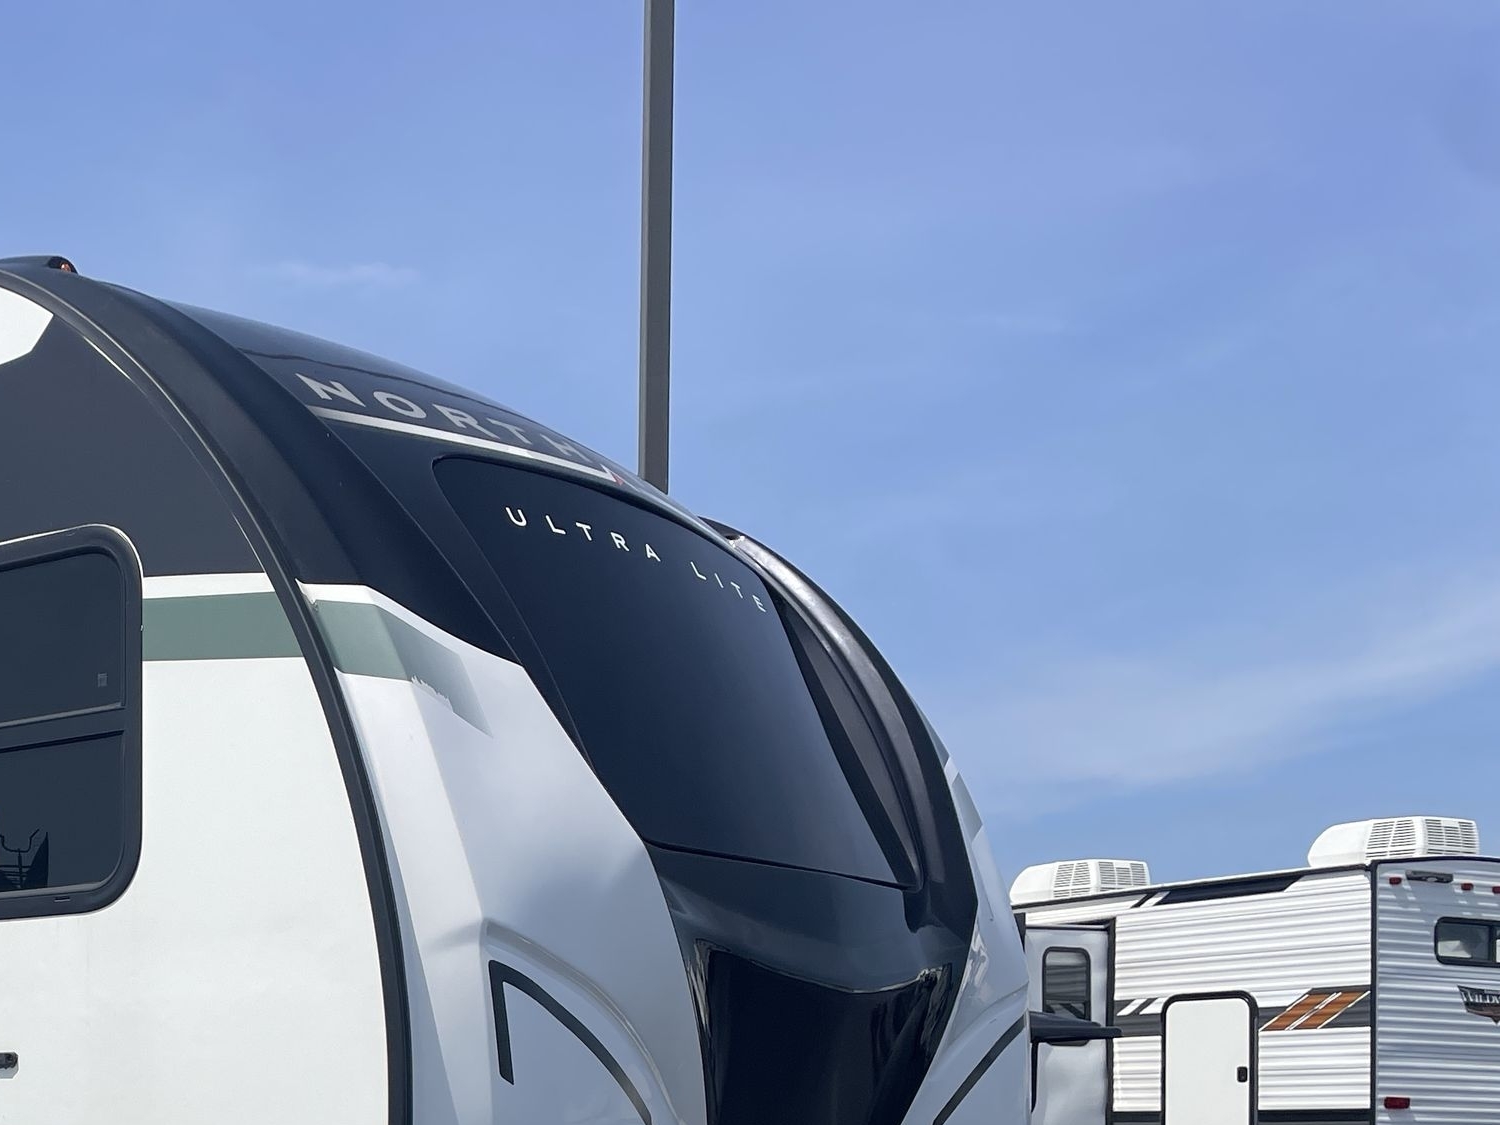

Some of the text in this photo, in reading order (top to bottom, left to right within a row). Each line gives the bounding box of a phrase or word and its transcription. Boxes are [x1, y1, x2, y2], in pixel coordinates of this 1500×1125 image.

[295, 373, 590, 462] NORTH
[505, 506, 767, 612] ULTRA LITE
